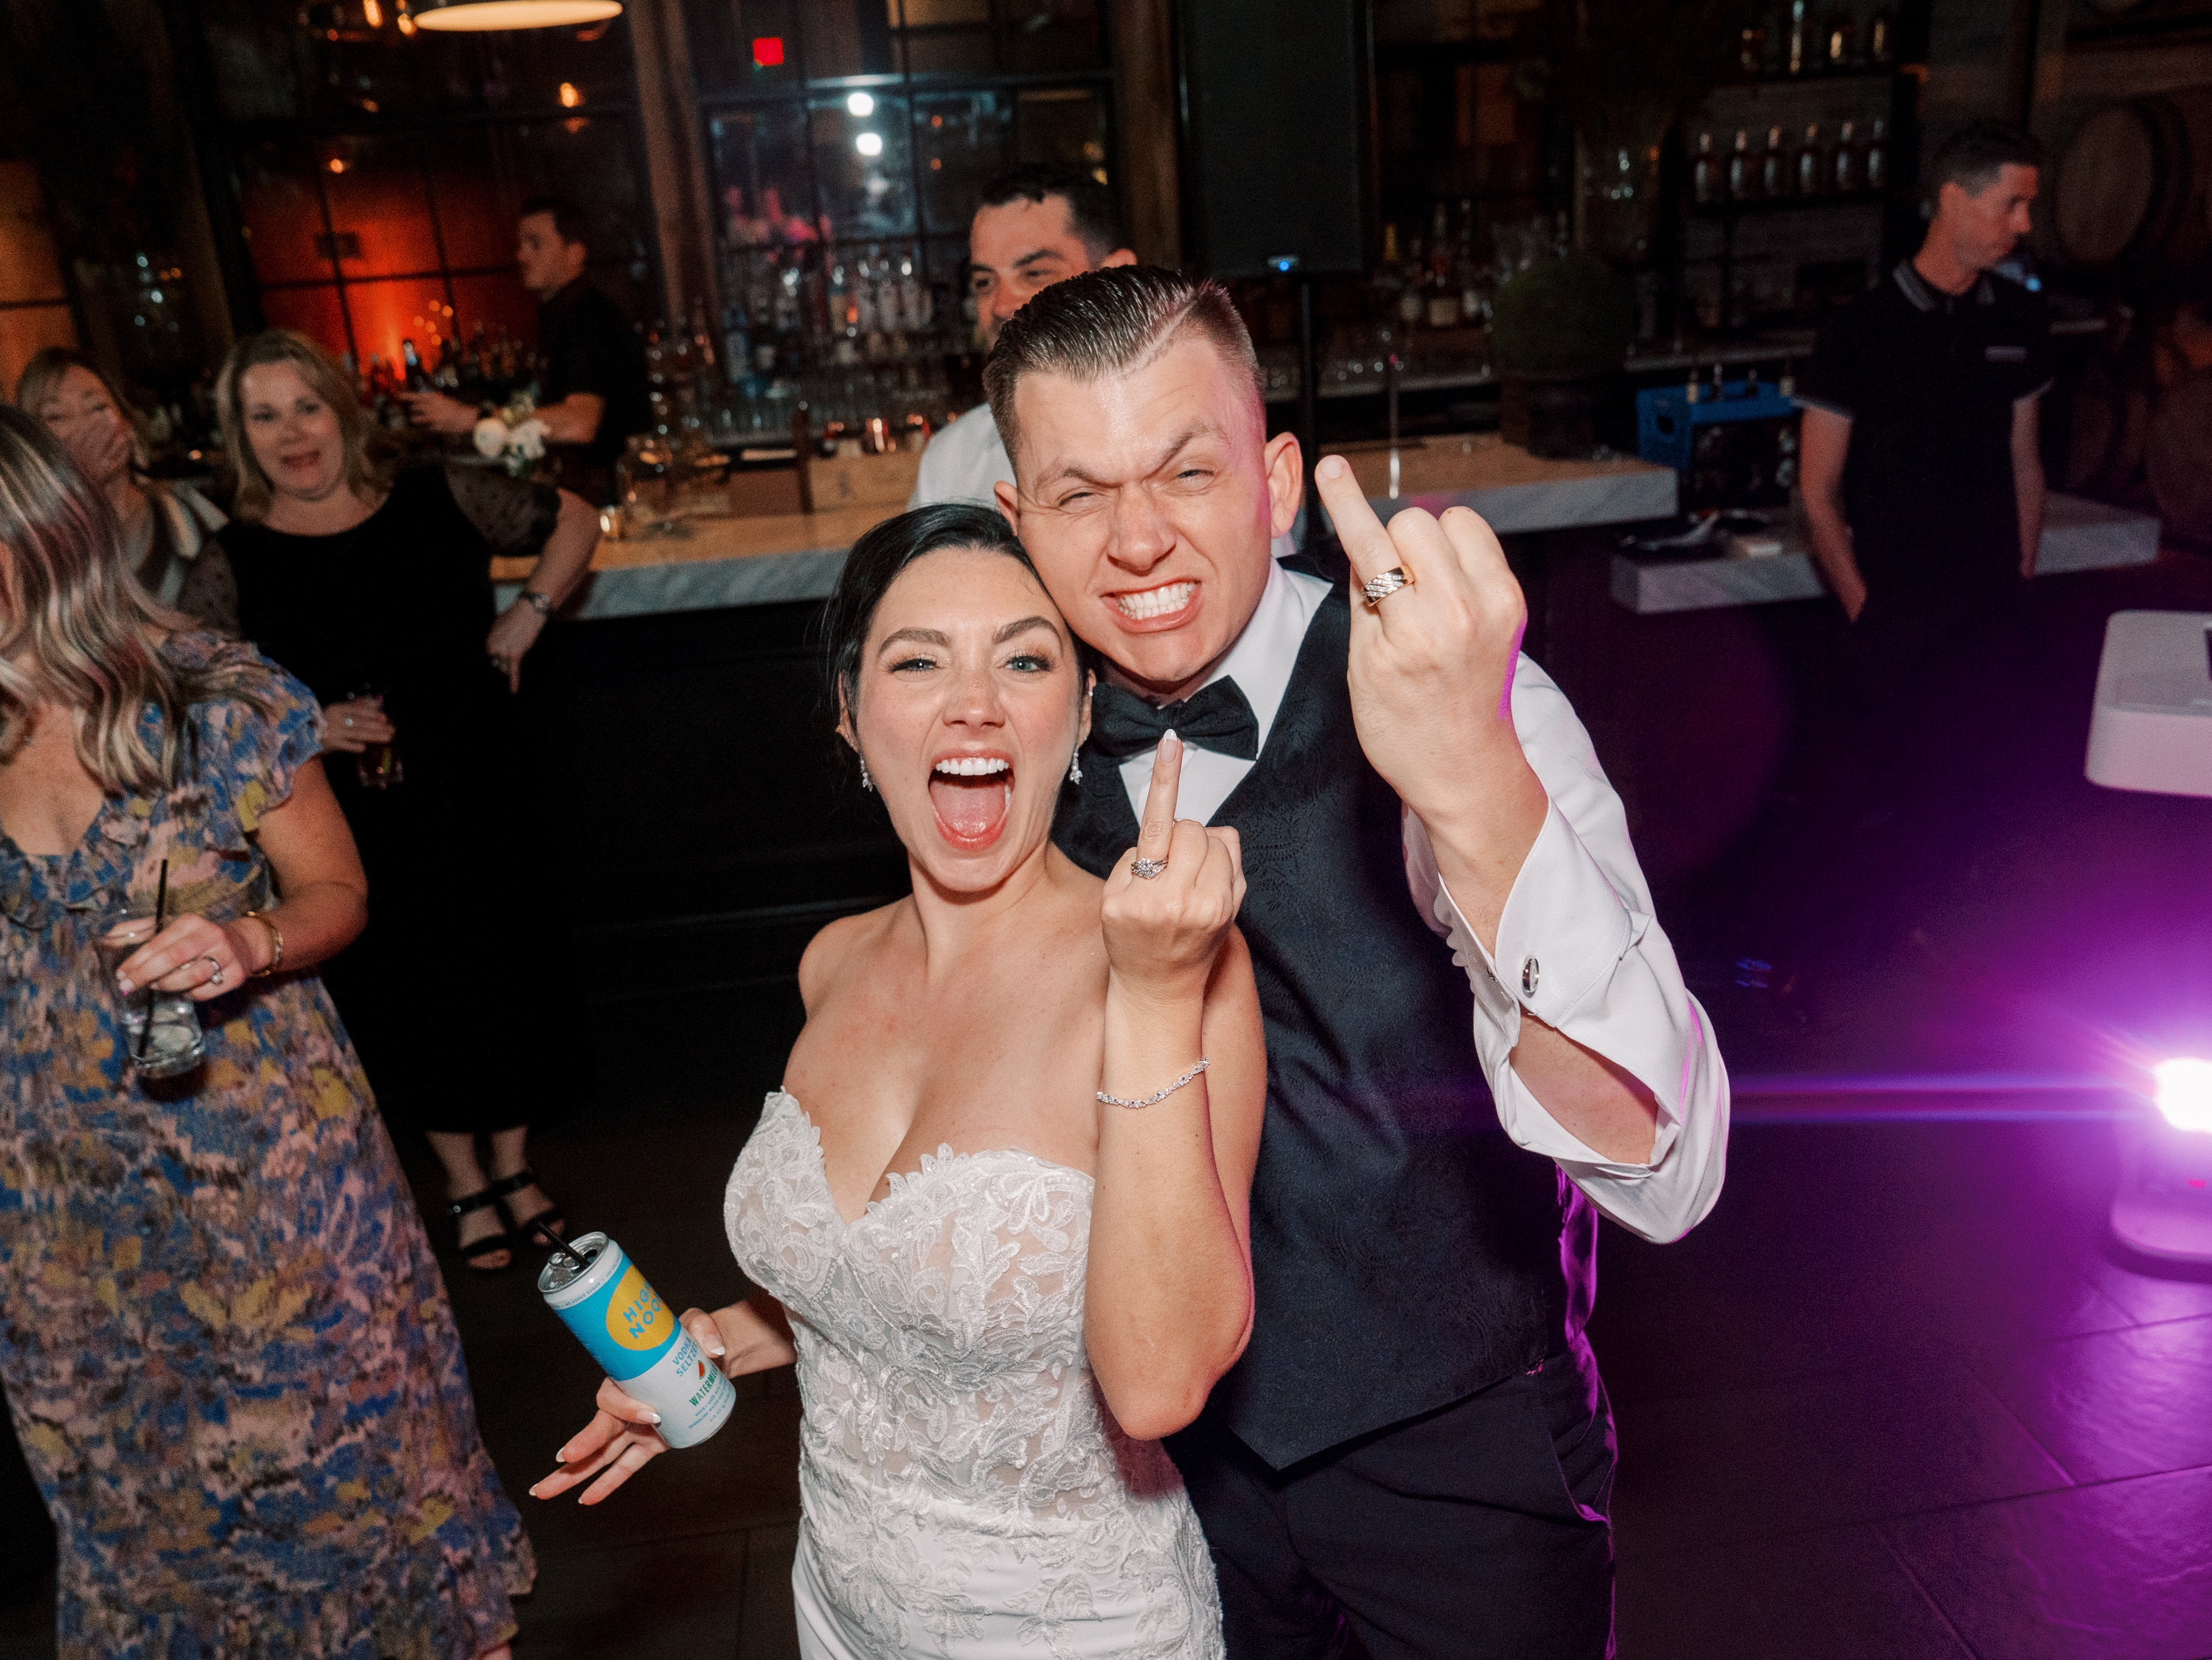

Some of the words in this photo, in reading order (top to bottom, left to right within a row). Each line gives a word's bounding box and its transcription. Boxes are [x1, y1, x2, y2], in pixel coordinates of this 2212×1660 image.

[571, 1293, 586, 1304] ADDED
[586, 1282, 601, 1294] SUGAR
[672, 1336, 692, 1365] VODKA
